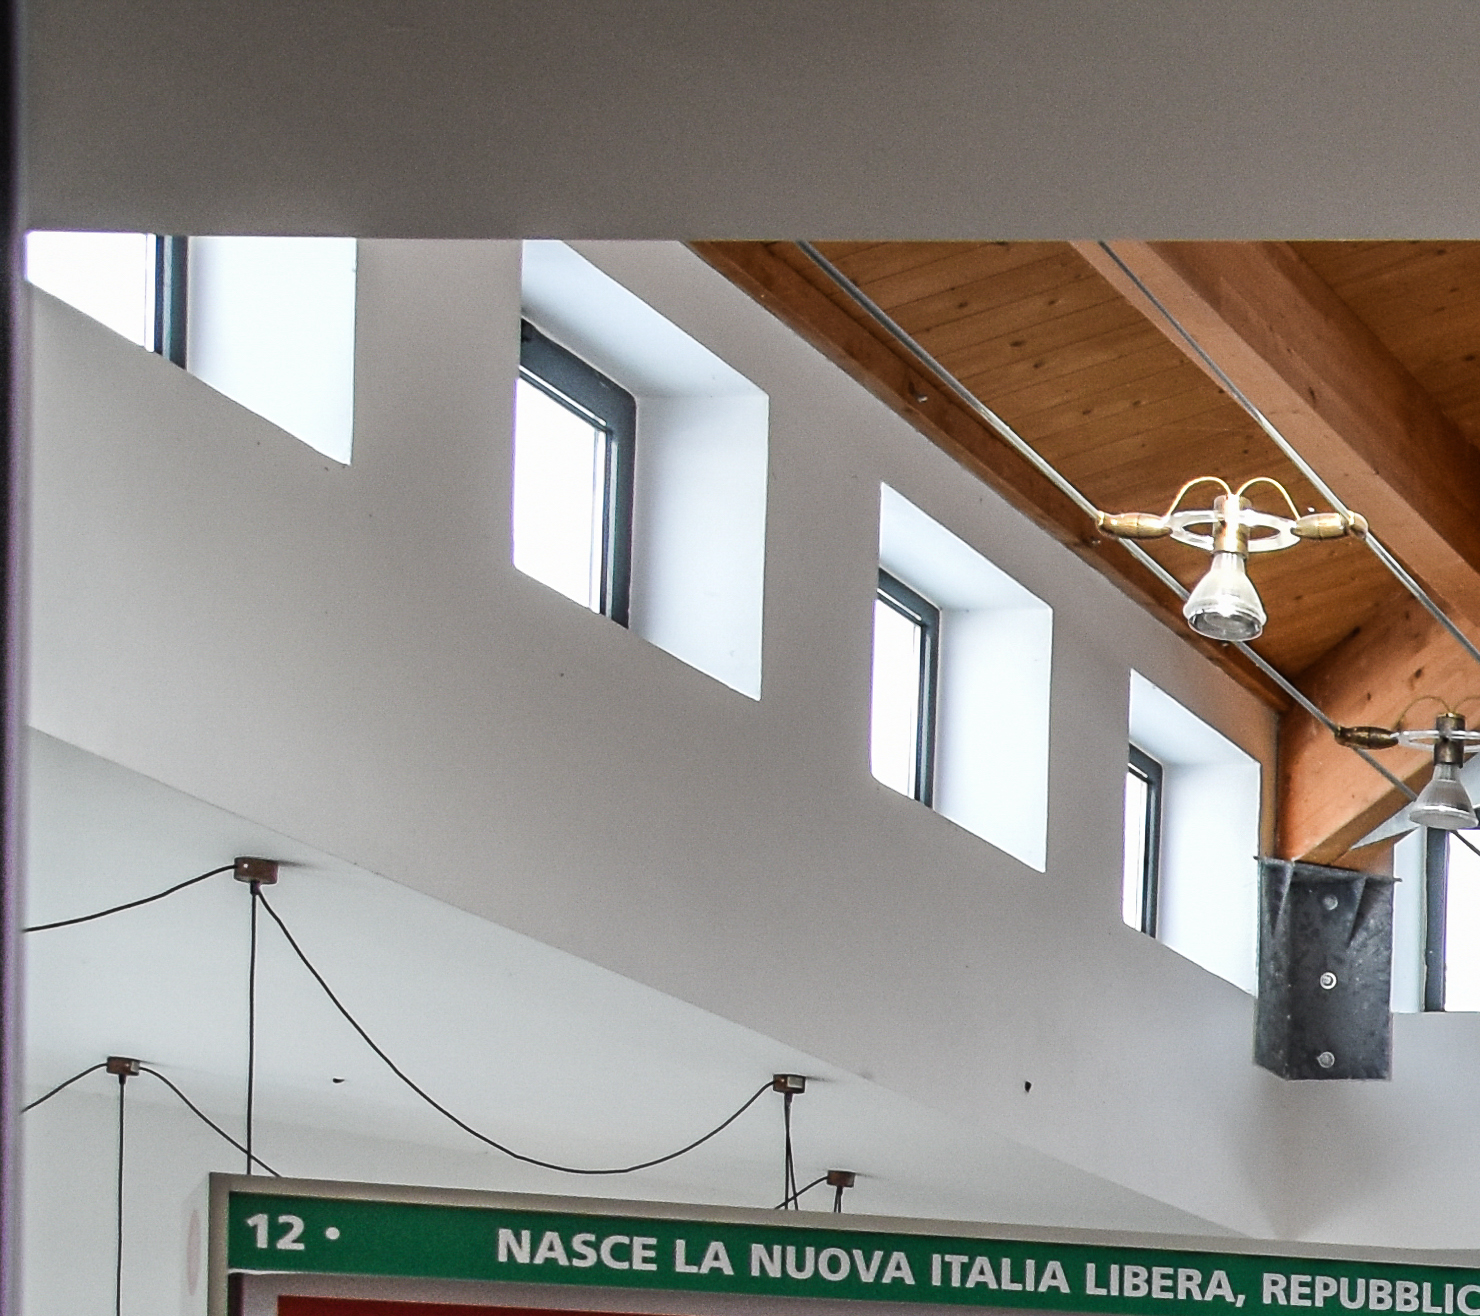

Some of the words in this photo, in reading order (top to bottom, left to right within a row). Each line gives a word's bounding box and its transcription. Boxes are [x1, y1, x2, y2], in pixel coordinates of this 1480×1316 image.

[246, 1213, 304, 1250] 12
[497, 1228, 657, 1271] NASCE
[675, 1239, 734, 1275] LA
[750, 1243, 915, 1285] NUOVA
[931, 1253, 1070, 1293] ITALIA
[1085, 1262, 1245, 1308] LIBERA,
